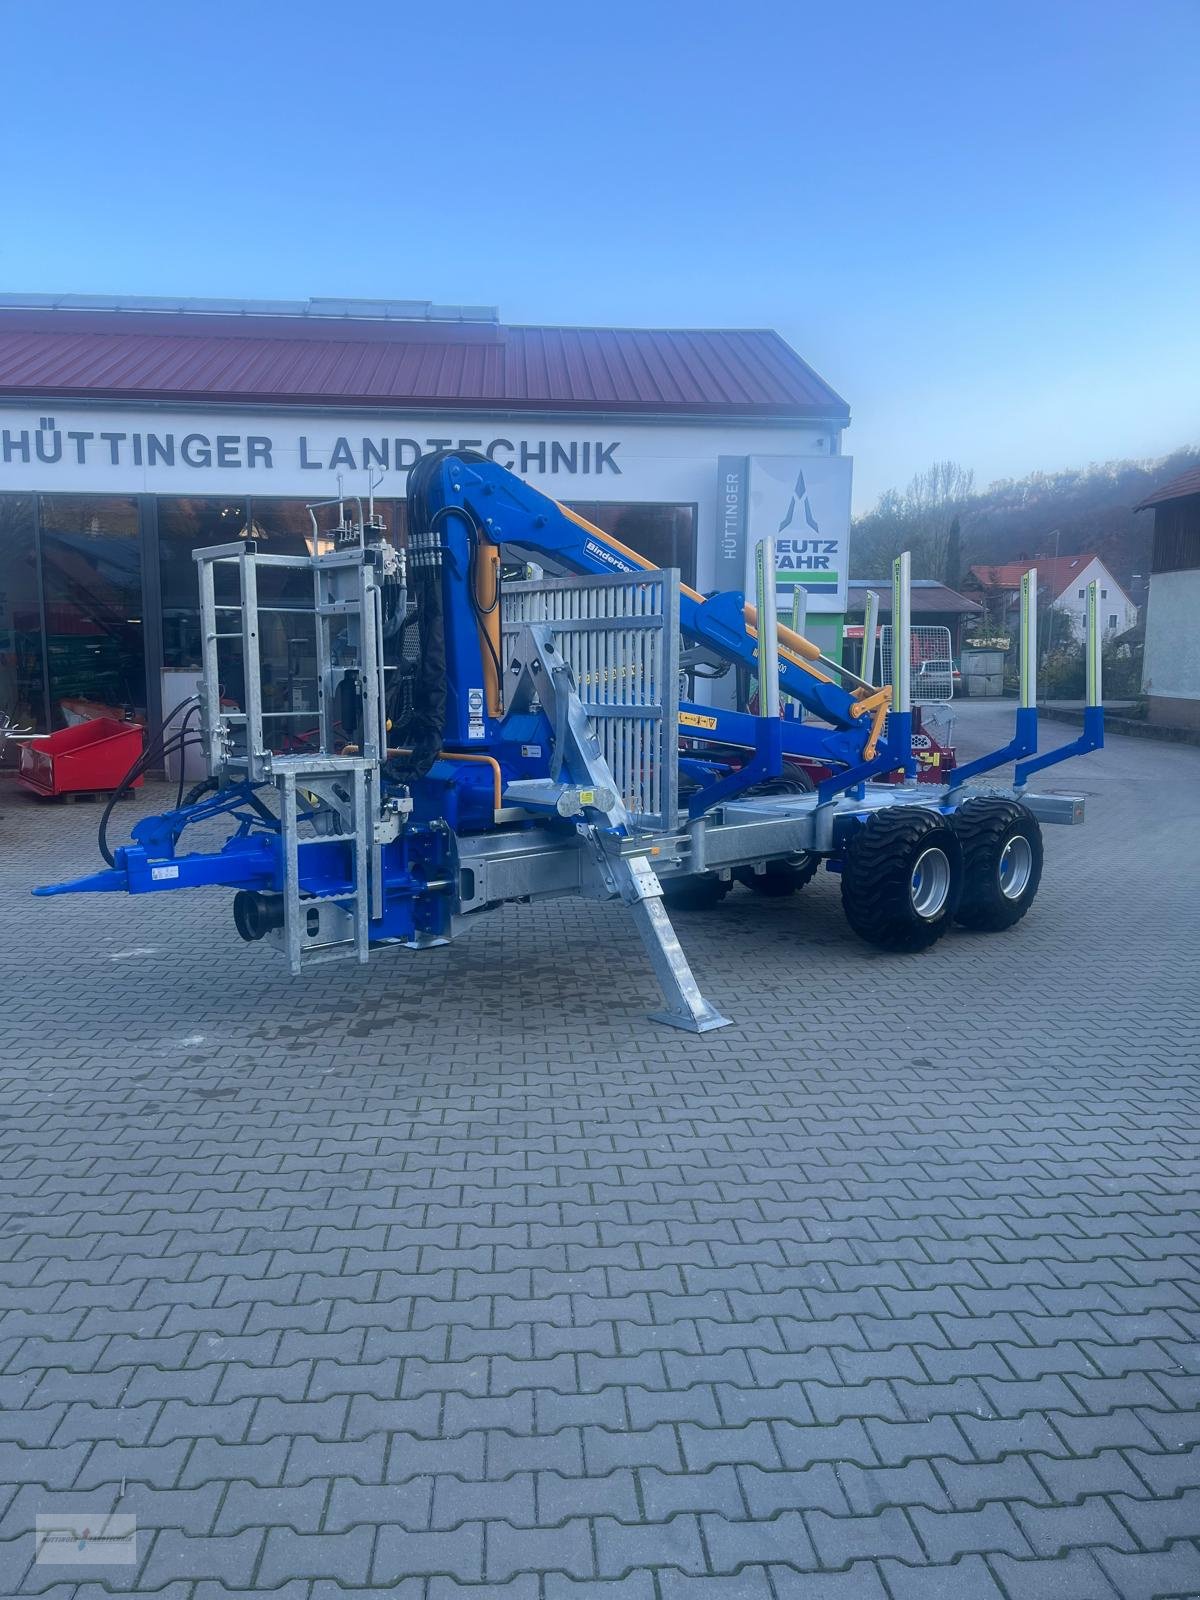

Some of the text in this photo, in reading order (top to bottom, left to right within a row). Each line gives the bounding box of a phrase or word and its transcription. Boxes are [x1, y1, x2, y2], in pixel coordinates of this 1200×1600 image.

[2, 417, 274, 470] HÜTTINGER
[721, 473, 739, 560] HÜTTINGER
[774, 539, 838, 554] EUTZ
